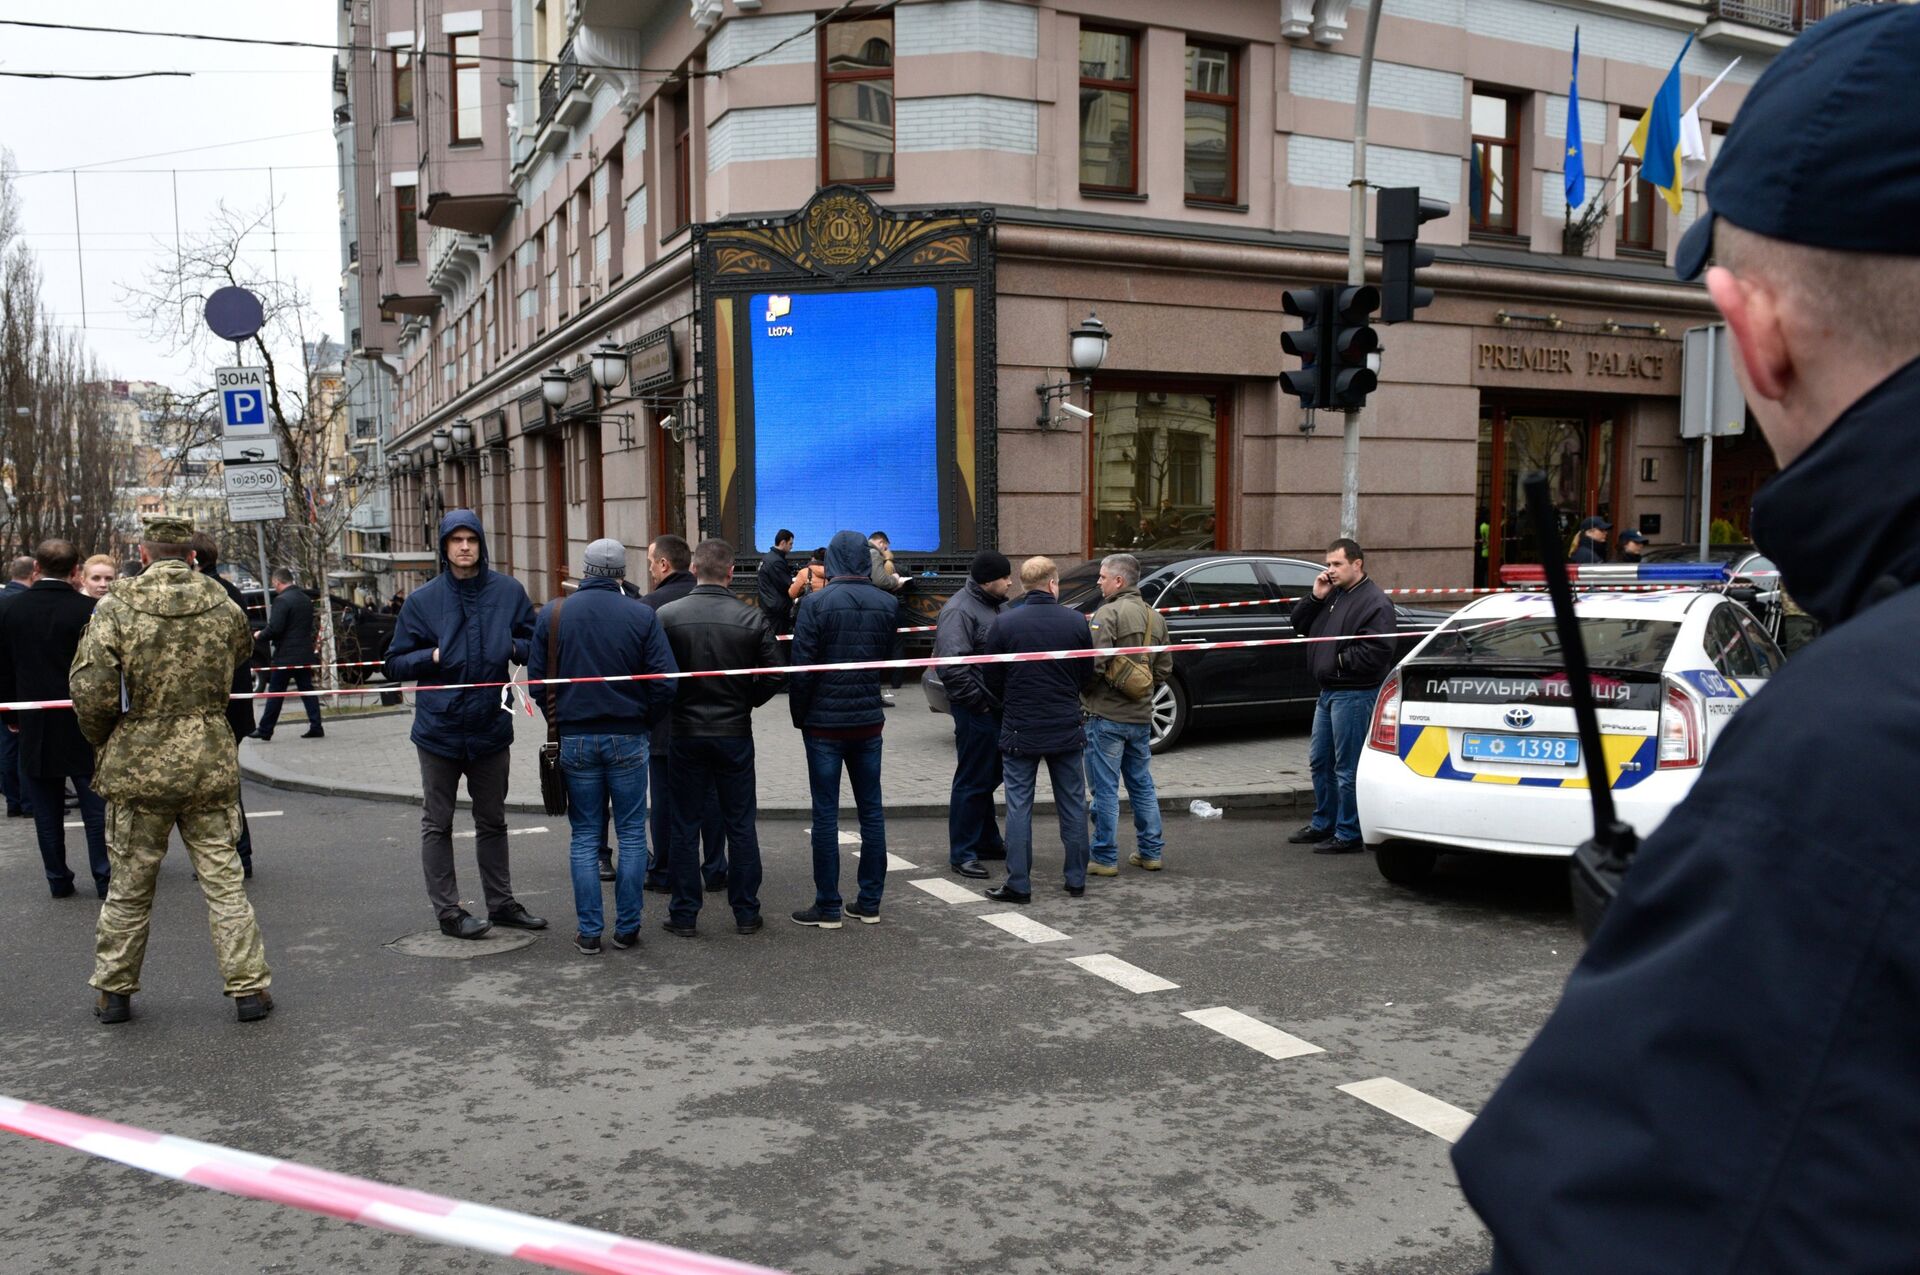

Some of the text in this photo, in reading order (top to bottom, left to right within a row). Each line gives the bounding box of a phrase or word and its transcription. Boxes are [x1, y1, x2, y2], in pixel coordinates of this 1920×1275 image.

[768, 326, 793, 337] Lt074
[1478, 344, 1664, 380] PREMIER PALACE
[219, 372, 261, 386] ЗОНА
[234, 393, 256, 422] P
[243, 475, 256, 484] 25
[259, 473, 273, 484] 50
[1426, 680, 1631, 700] ПАТРУЛЬНА ПОІЦІЯ
[1517, 739, 1566, 759] 1398
